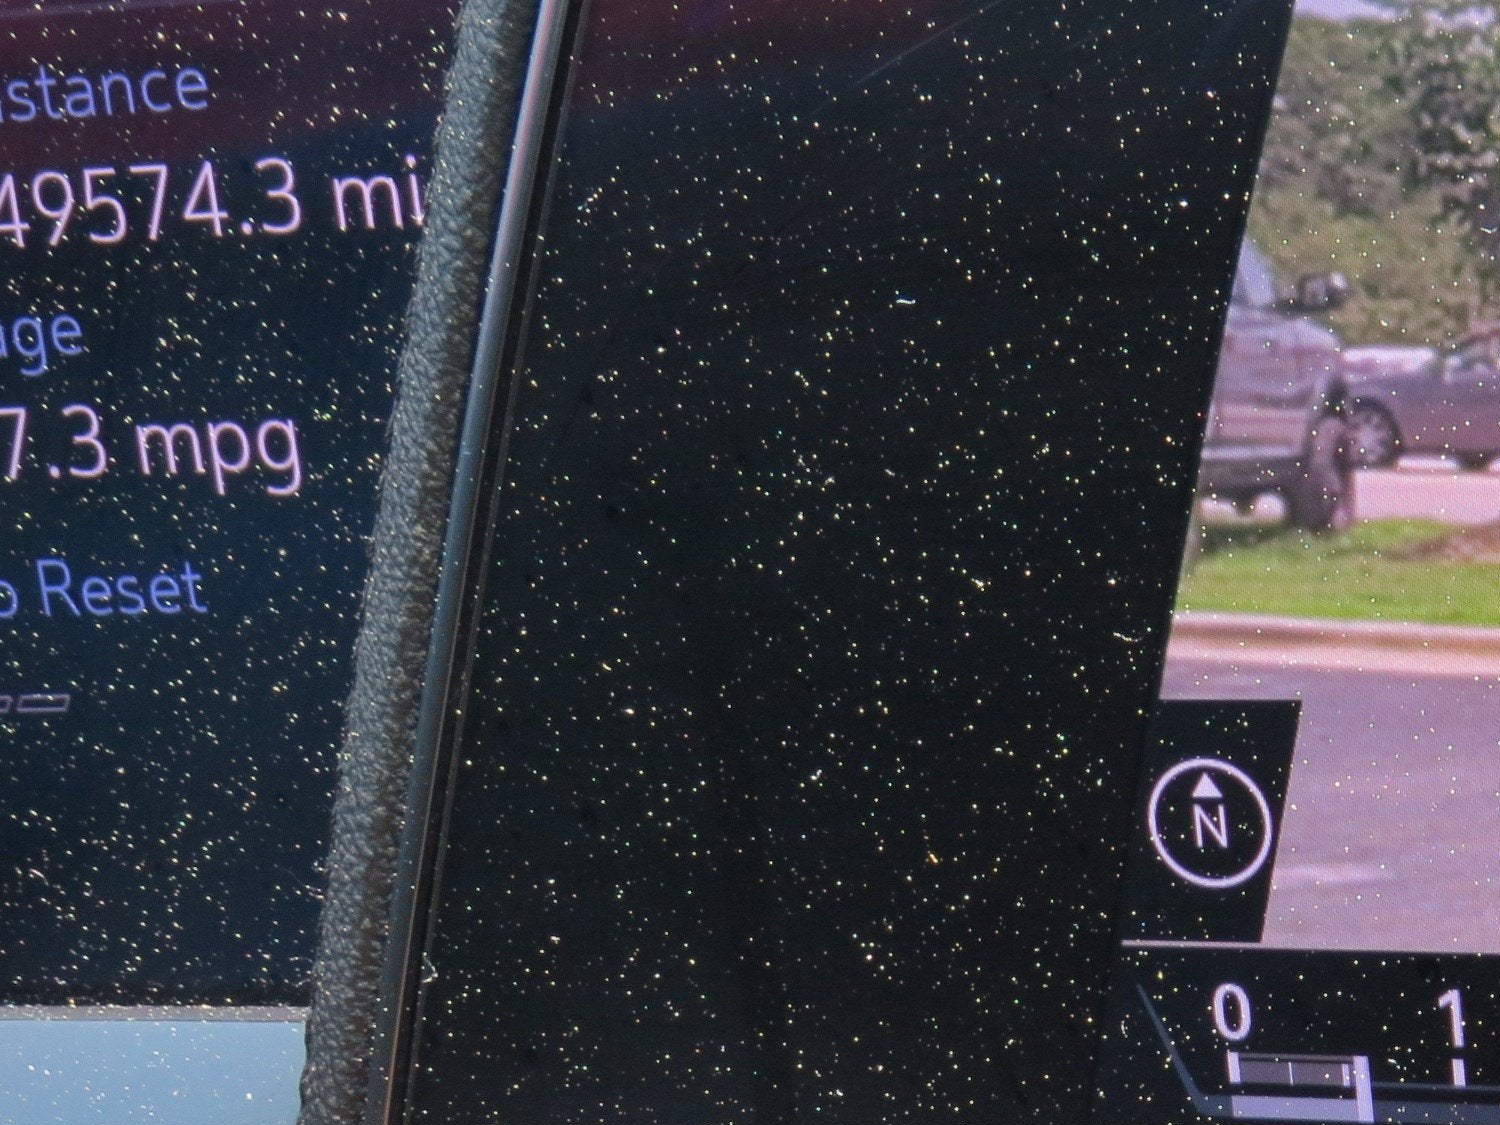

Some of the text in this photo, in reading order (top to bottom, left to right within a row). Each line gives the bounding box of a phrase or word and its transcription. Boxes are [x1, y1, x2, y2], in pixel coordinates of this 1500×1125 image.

[0, 65, 209, 123] stance
[332, 155, 426, 232] mi
[136, 418, 302, 497] mpg
[36, 558, 208, 617] Reset
[1194, 803, 1229, 849] N
[1212, 983, 1252, 1041] 0
[1438, 989, 1465, 1048] 1
